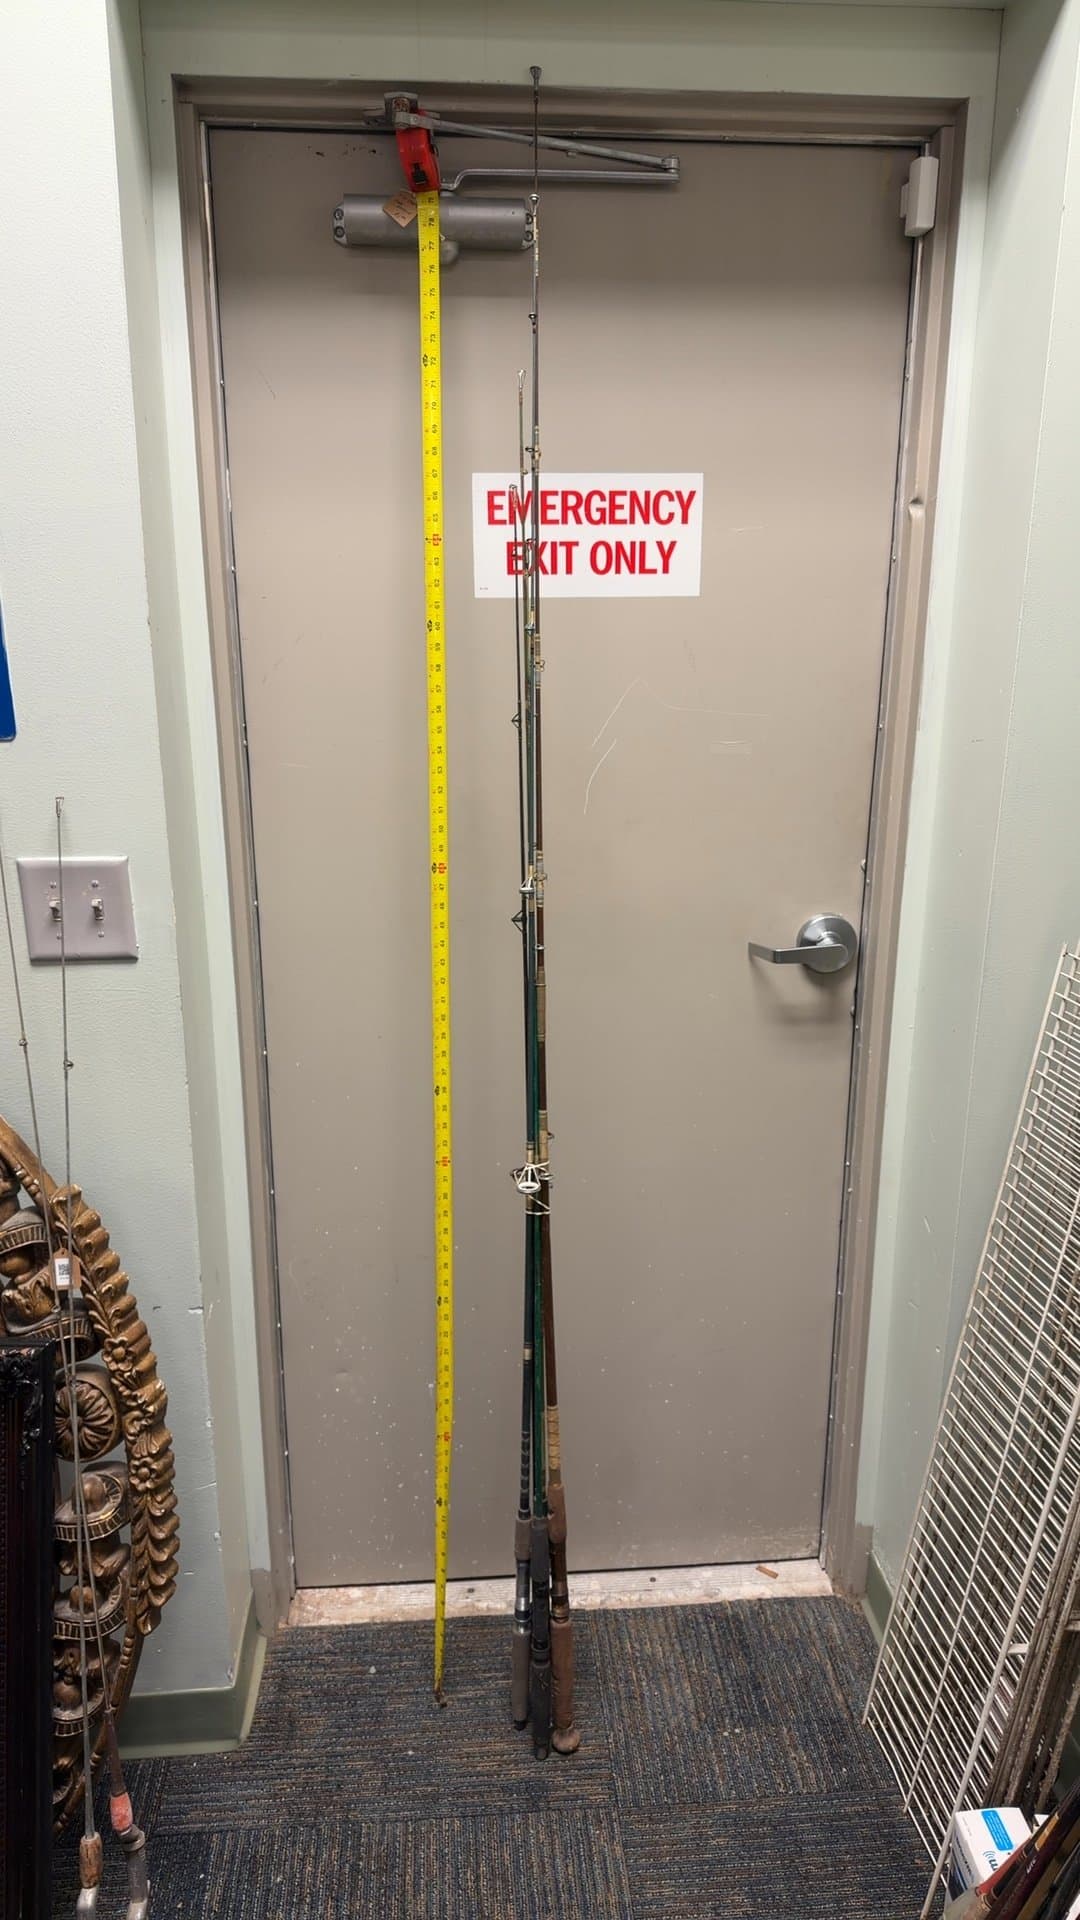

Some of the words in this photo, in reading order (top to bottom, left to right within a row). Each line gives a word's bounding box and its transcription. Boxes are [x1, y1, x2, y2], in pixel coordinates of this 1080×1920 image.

[487, 490, 696, 525] EMERGENCY
[507, 541, 579, 575] EXIT
[589, 540, 677, 575] ONLY
